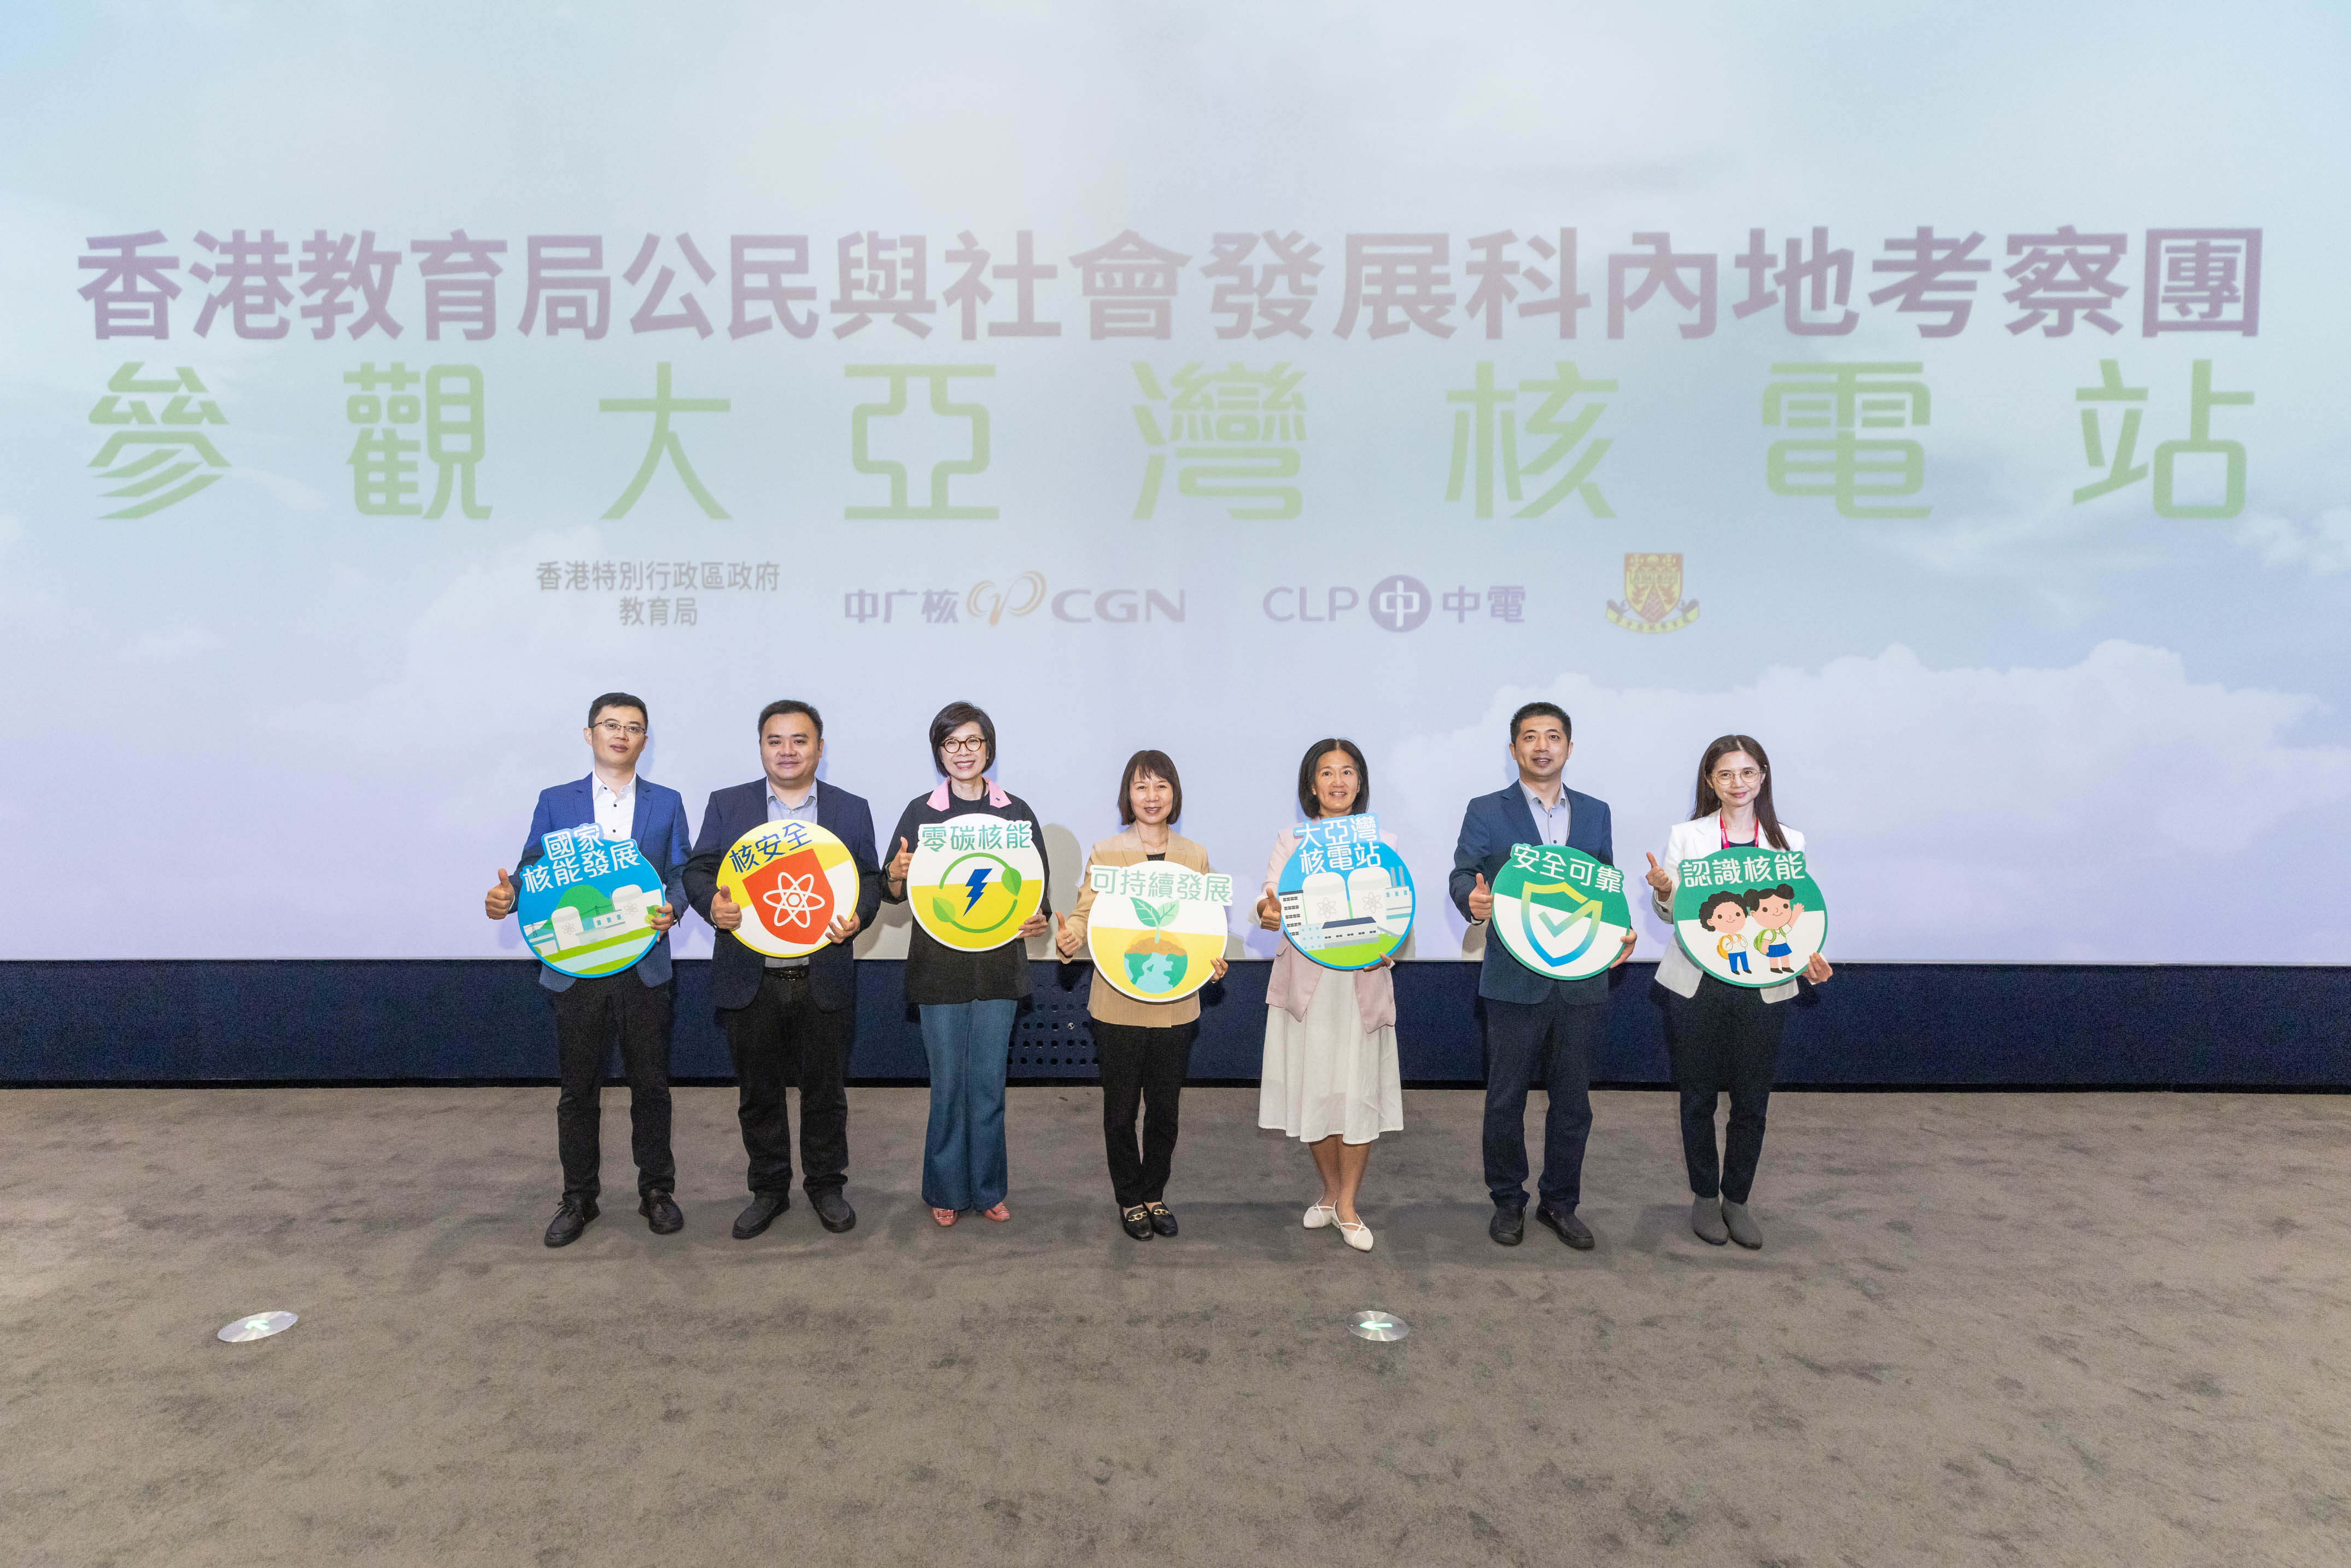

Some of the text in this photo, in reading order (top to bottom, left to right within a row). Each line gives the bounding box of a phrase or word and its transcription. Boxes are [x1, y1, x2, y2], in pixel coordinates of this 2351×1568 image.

[88, 359, 2255, 521] 參觀大亞灣核電站
[536, 561, 780, 591] 香港特別行政區政府
[619, 596, 698, 627] 教育局
[844, 588, 1186, 624] 中广核 CGN
[1263, 586, 1359, 622] CLP
[1442, 585, 1527, 623] 中電
[543, 824, 604, 861] 國家
[729, 822, 813, 874] 核安全
[922, 823, 1031, 852] 零碳核能
[1296, 815, 1378, 848] 大亞灣
[523, 844, 640, 893] 核能發展
[1300, 841, 1382, 875] 核電站
[1513, 845, 1623, 893] 安全可靠
[1682, 853, 1805, 887] 認識核能
[1093, 867, 1232, 903] 可持續發展
